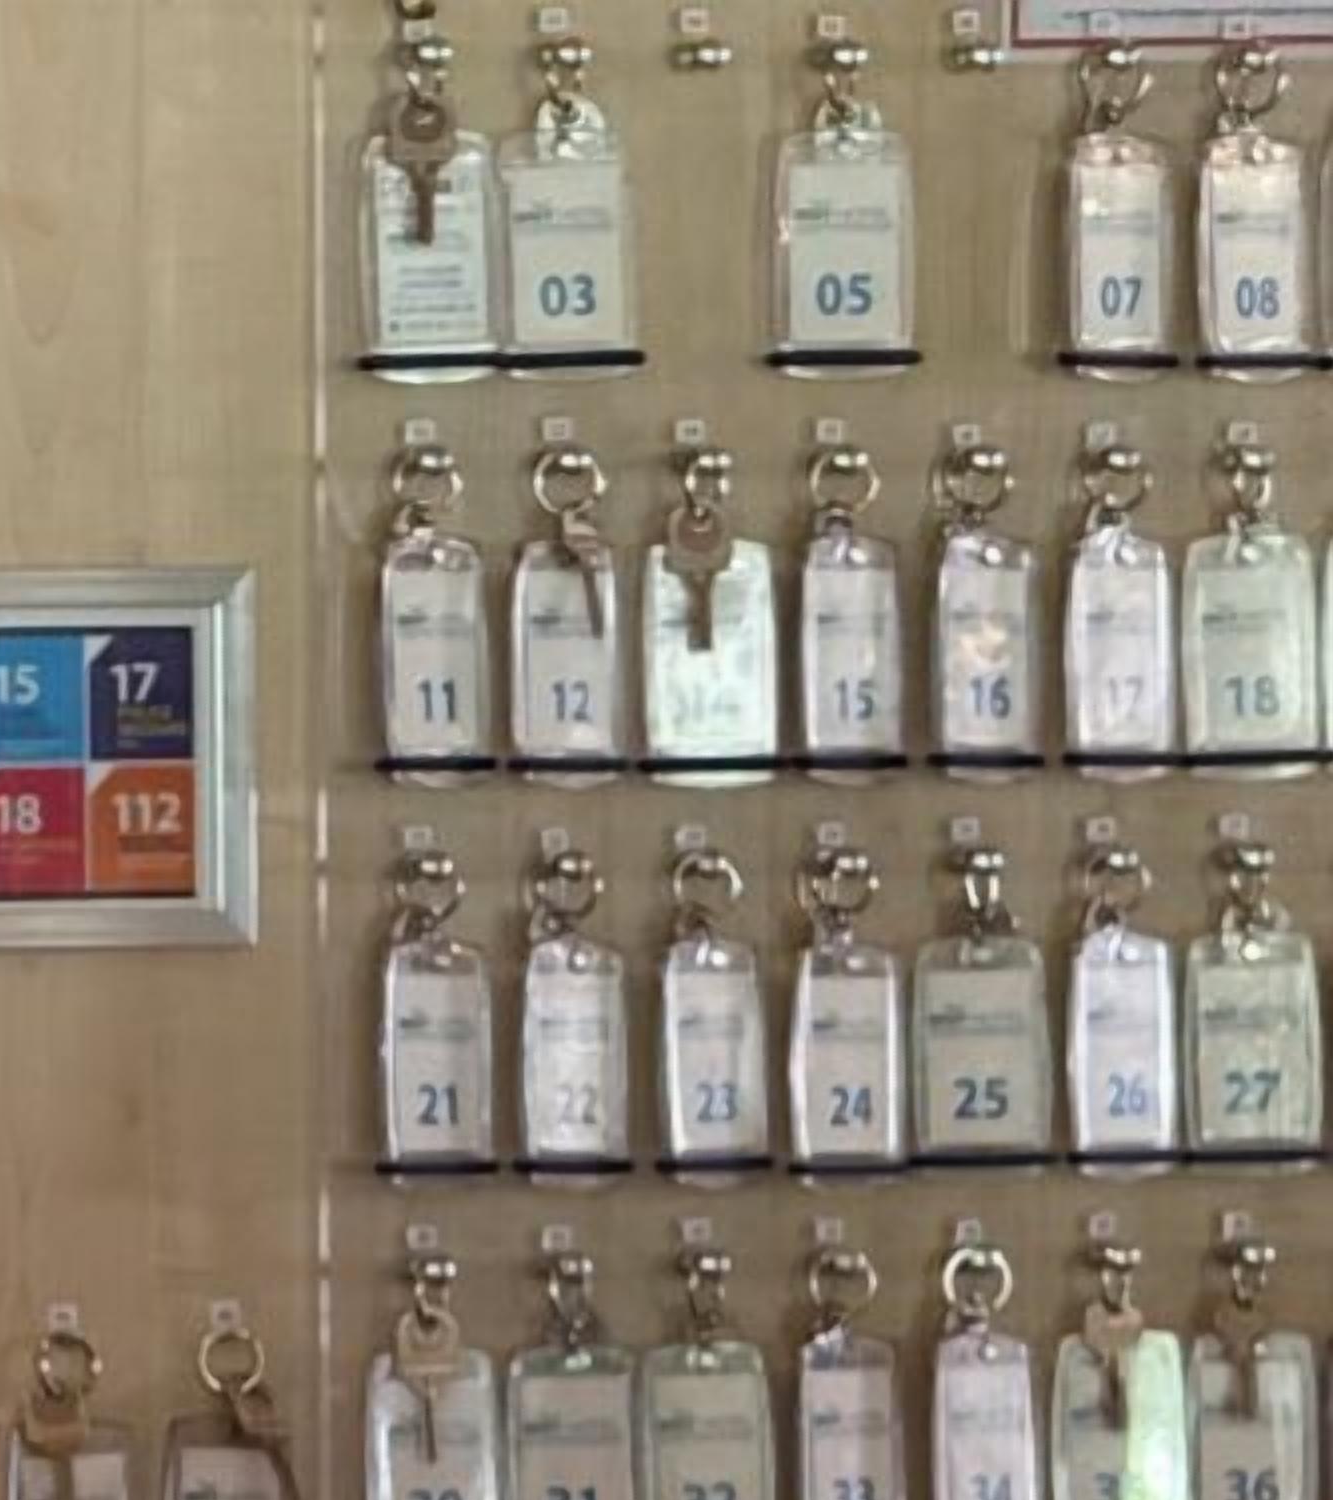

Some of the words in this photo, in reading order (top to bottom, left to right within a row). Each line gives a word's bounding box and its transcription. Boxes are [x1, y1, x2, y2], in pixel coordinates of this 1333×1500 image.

[539, 273, 596, 317] 03
[816, 272, 873, 317] 05
[1100, 274, 1142, 317] 07
[1235, 275, 1280, 318] 08
[109, 662, 159, 703] 17
[418, 680, 459, 722] 11
[552, 680, 592, 723] 12
[834, 679, 877, 722] 15
[970, 678, 1013, 720] 16
[1225, 675, 1280, 719] 18
[111, 792, 182, 835] 112
[417, 1083, 460, 1126] 21
[557, 1084, 598, 1125] 22
[697, 1080, 738, 1123] 23
[830, 1084, 874, 1128] 24
[954, 1075, 1009, 1119] 25
[1107, 1074, 1149, 1116] 26
[1224, 1071, 1281, 1114] 27
